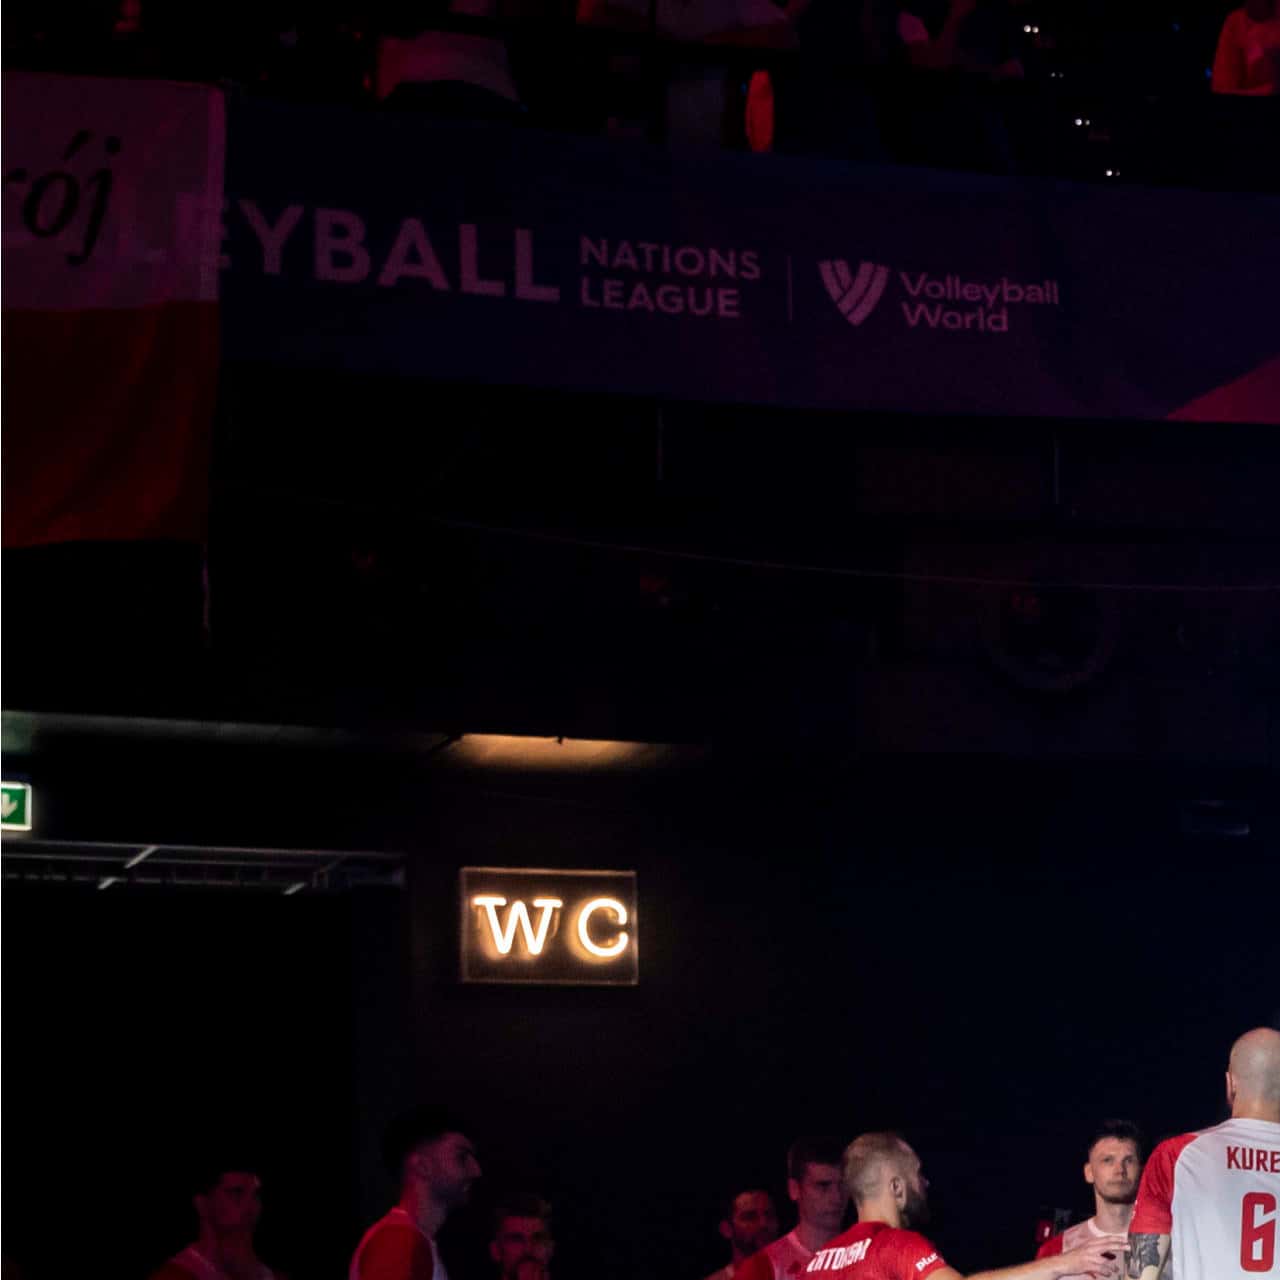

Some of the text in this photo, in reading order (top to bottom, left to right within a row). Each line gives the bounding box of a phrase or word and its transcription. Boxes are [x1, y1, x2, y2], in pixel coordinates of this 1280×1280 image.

[176, 193, 560, 302] EYBALL
[577, 232, 761, 281] NATIONS
[579, 275, 741, 318] LEAGUE
[901, 271, 1060, 310] Volleyball
[902, 300, 1008, 333] World
[473, 896, 629, 957] WC
[1240, 1191, 1277, 1273] 6
